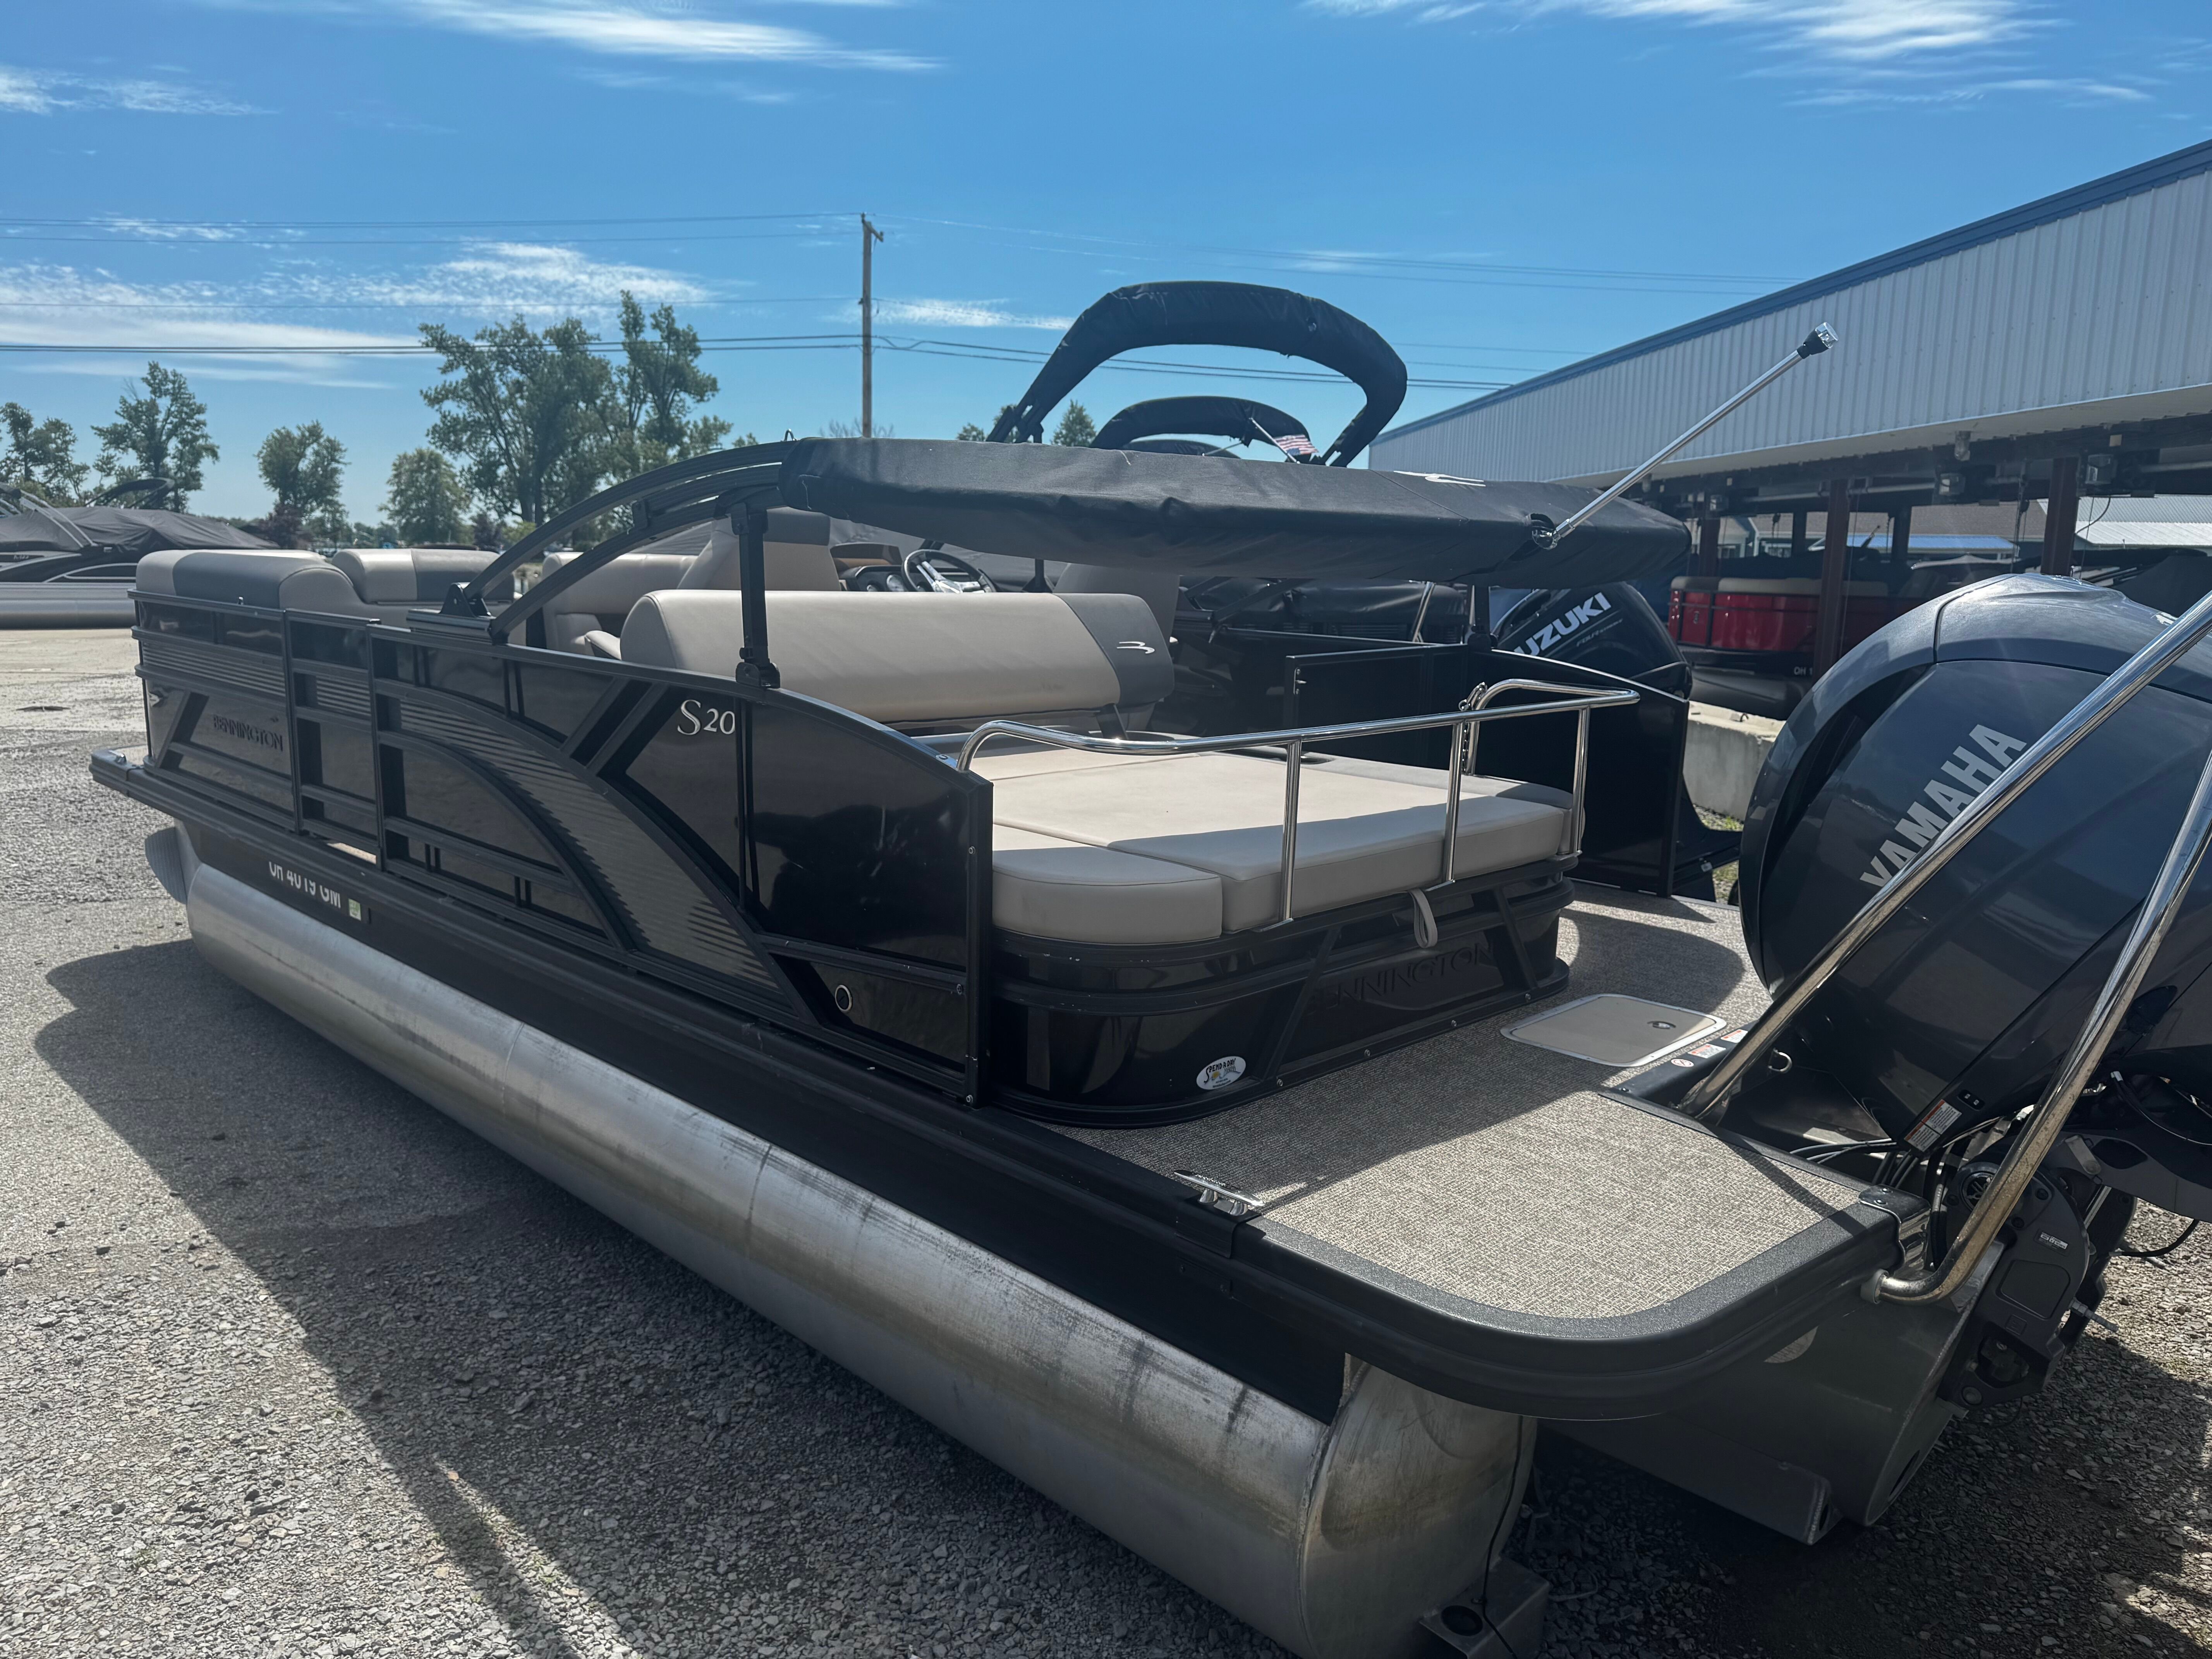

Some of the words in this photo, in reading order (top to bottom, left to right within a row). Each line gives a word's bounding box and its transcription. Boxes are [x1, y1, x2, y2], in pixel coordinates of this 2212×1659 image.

[213, 715, 283, 752] BENNINGTON
[677, 699, 735, 735] S20
[1860, 724, 2027, 888] YAMAHA
[1204, 1062, 1222, 1083] SPEND
[1227, 1058, 1236, 1067] DAY
